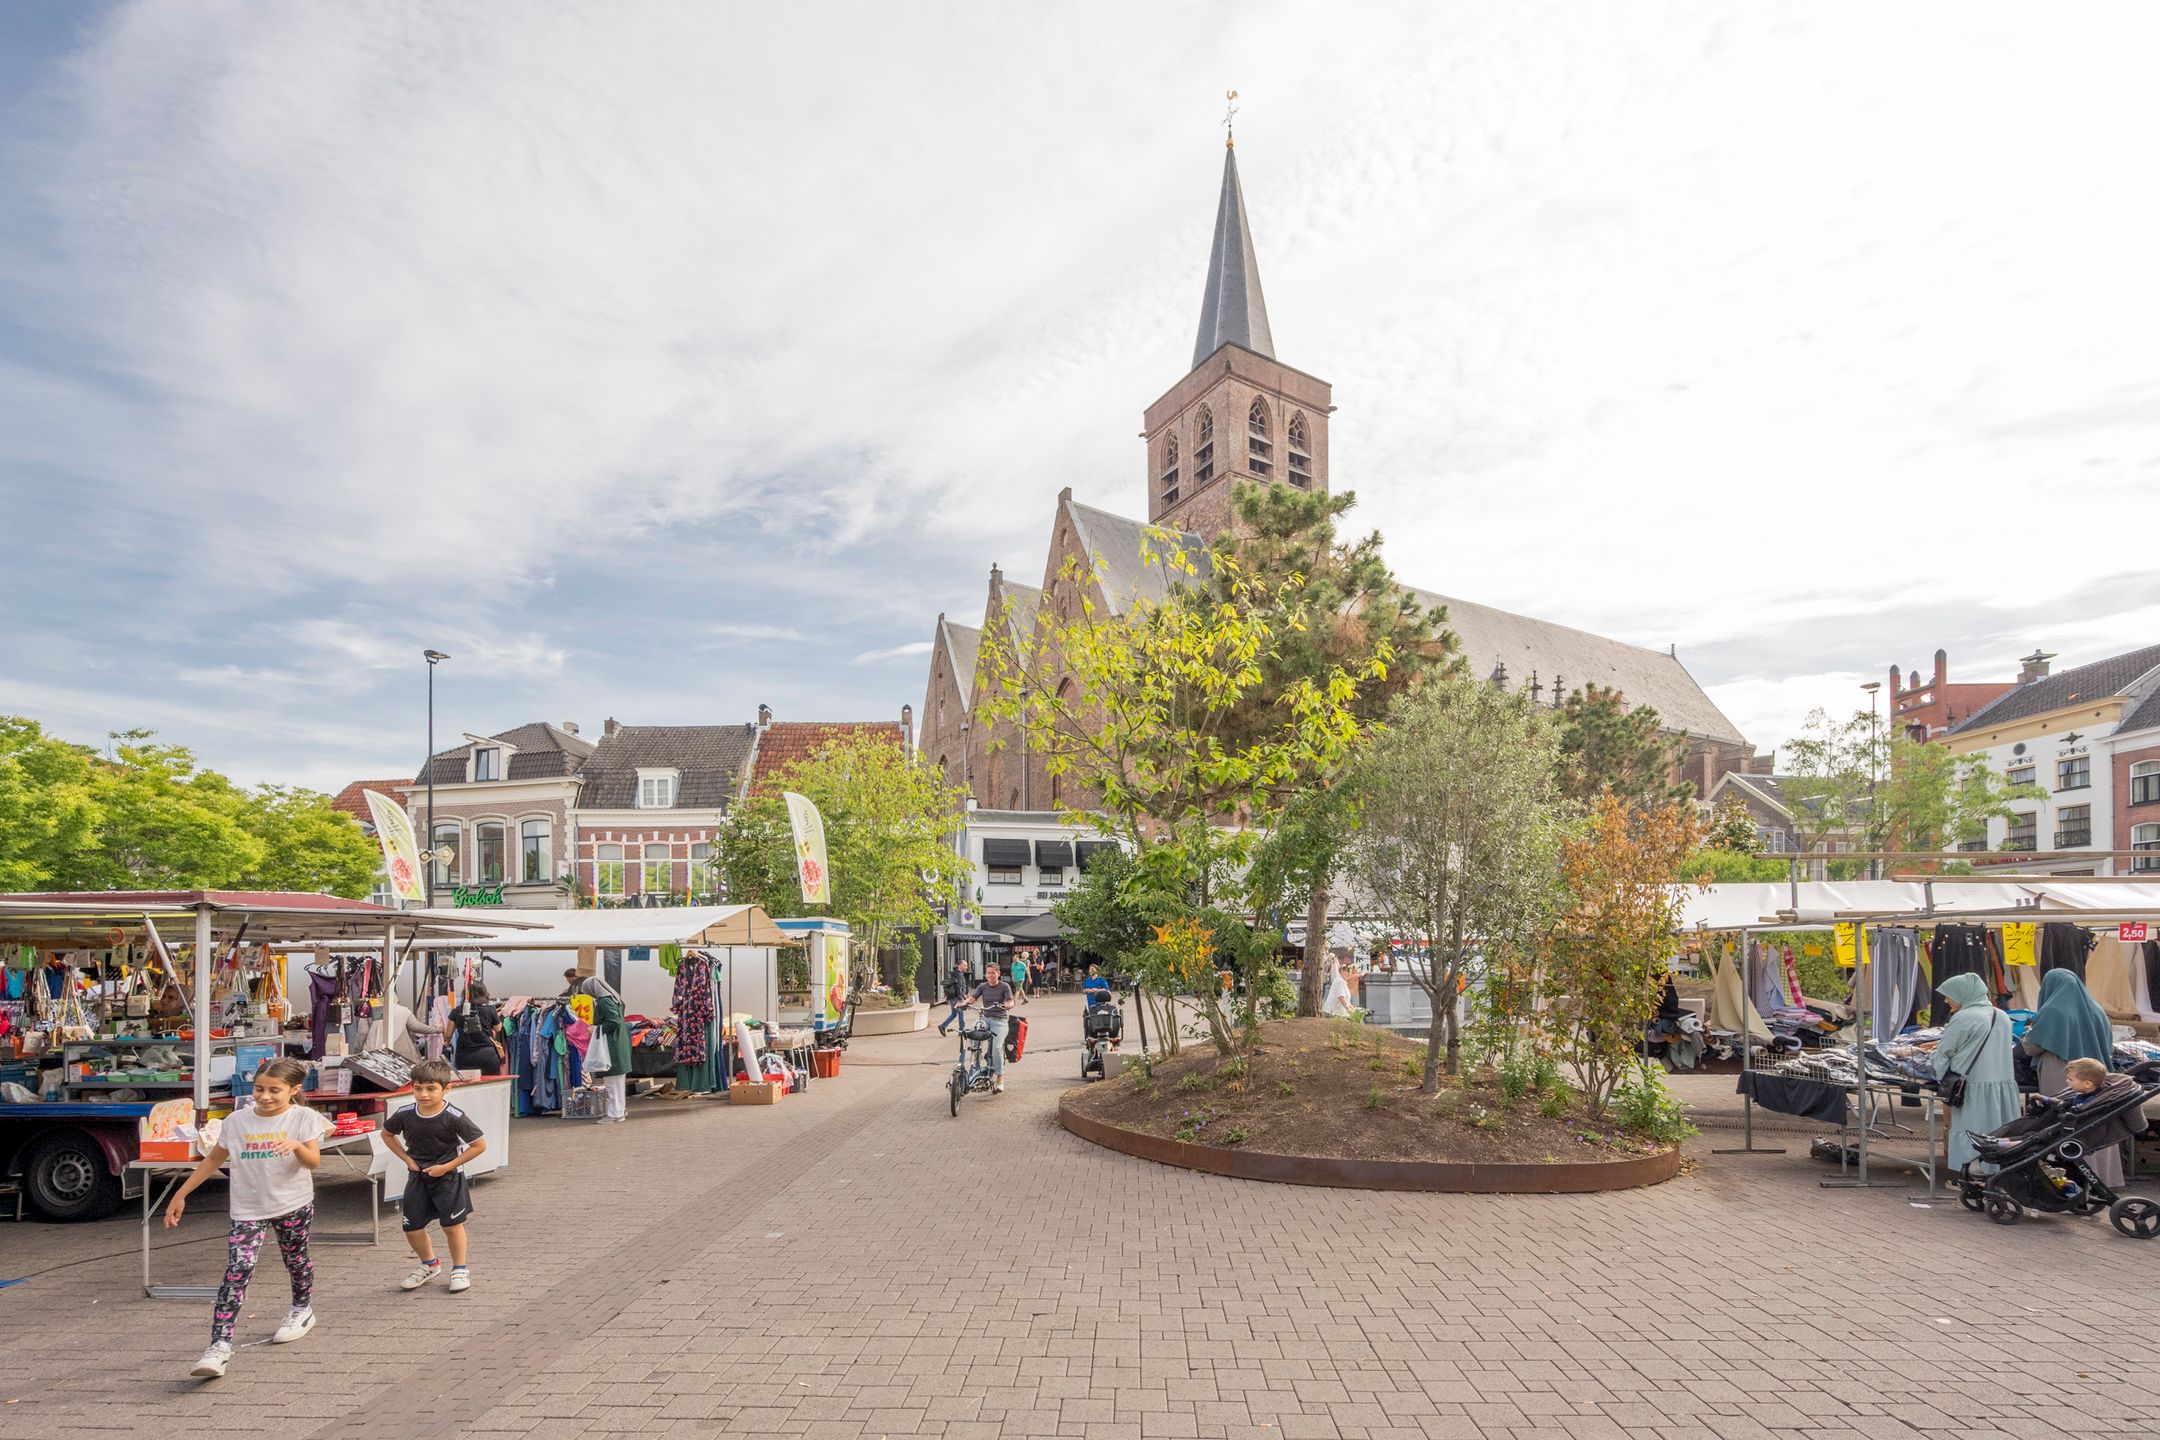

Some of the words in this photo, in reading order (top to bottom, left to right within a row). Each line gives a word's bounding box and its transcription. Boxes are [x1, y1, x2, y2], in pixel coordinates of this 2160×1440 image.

[453, 885, 503, 909] Grolsch
[2122, 927, 2144, 939] 2,50
[241, 1151, 280, 1160] PISTAC
[2079, 1164, 2098, 1184] urban
